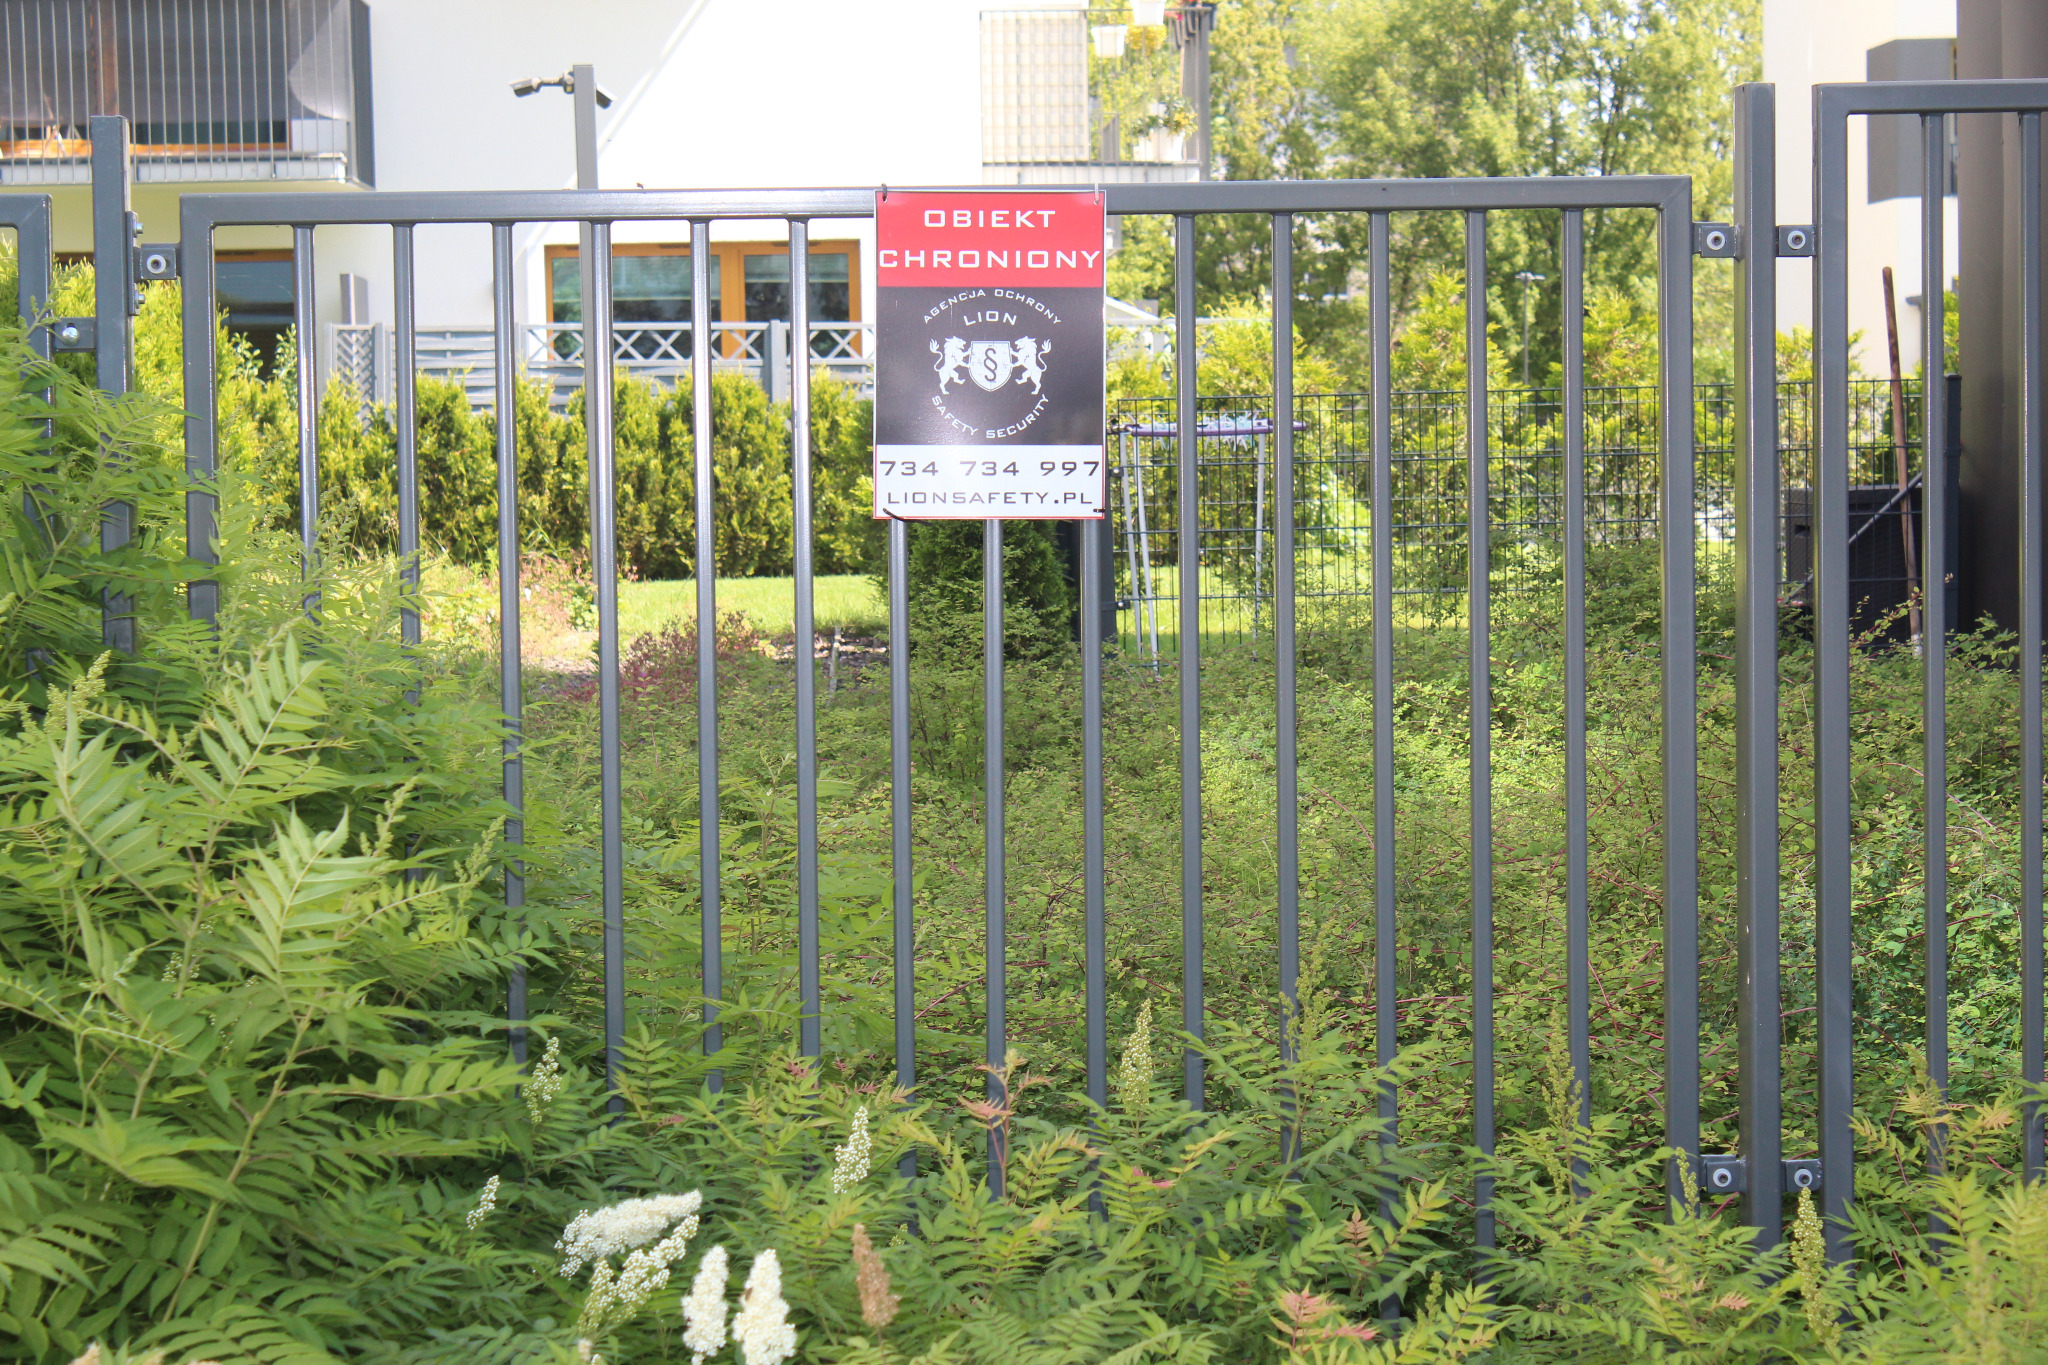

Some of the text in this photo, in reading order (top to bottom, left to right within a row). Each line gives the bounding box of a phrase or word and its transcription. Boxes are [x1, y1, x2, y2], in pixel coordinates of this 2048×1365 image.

[924, 209, 1056, 228] OBIEKT
[879, 249, 1101, 268] CHRONIONY
[923, 288, 1062, 325] AGENCJA OCHRONY
[963, 310, 1018, 326] LION
[931, 394, 1049, 439] SAFETY SECURITY
[879, 460, 1100, 477] 734 734 997
[887, 491, 1093, 505] LIONSAFETY.PL
